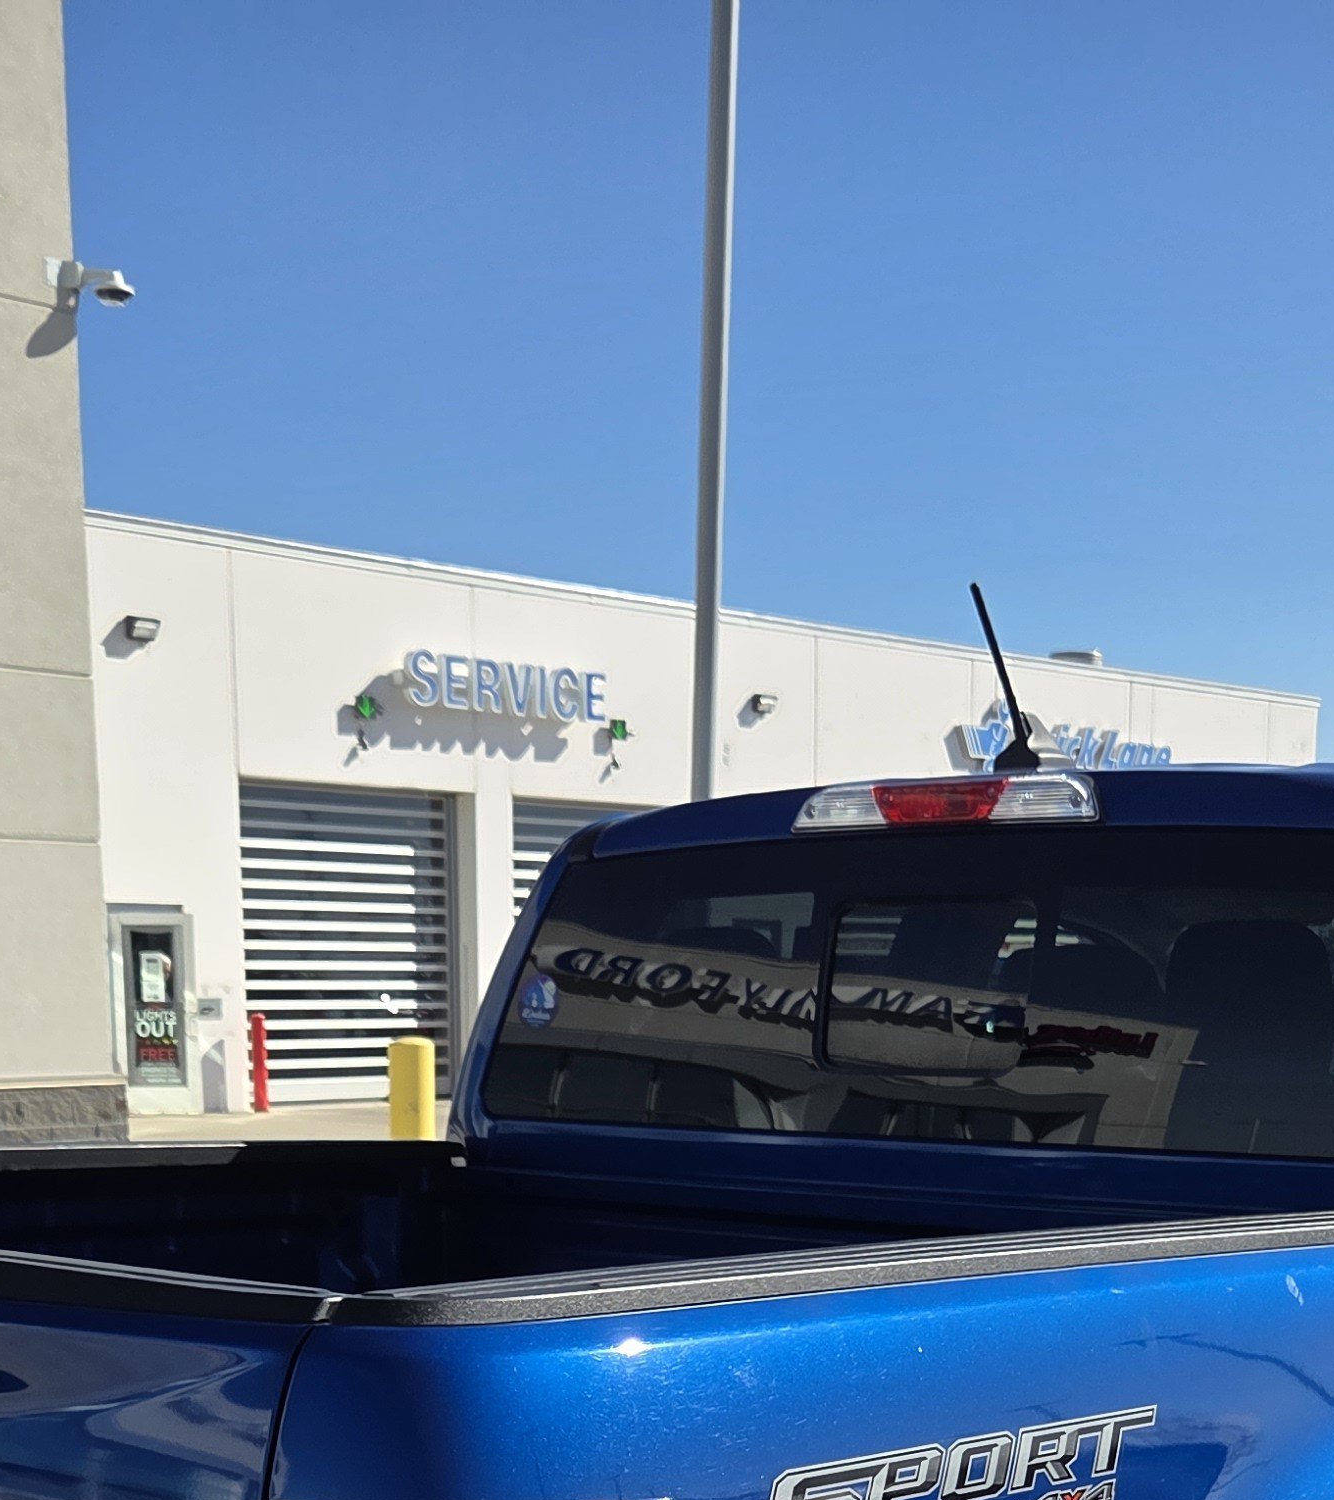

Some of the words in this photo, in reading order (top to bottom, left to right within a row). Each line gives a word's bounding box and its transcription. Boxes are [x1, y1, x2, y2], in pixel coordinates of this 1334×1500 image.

[405, 649, 607, 723] SERVICE
[135, 1020, 177, 1038] OUT
[139, 1048, 176, 1061] FREE
